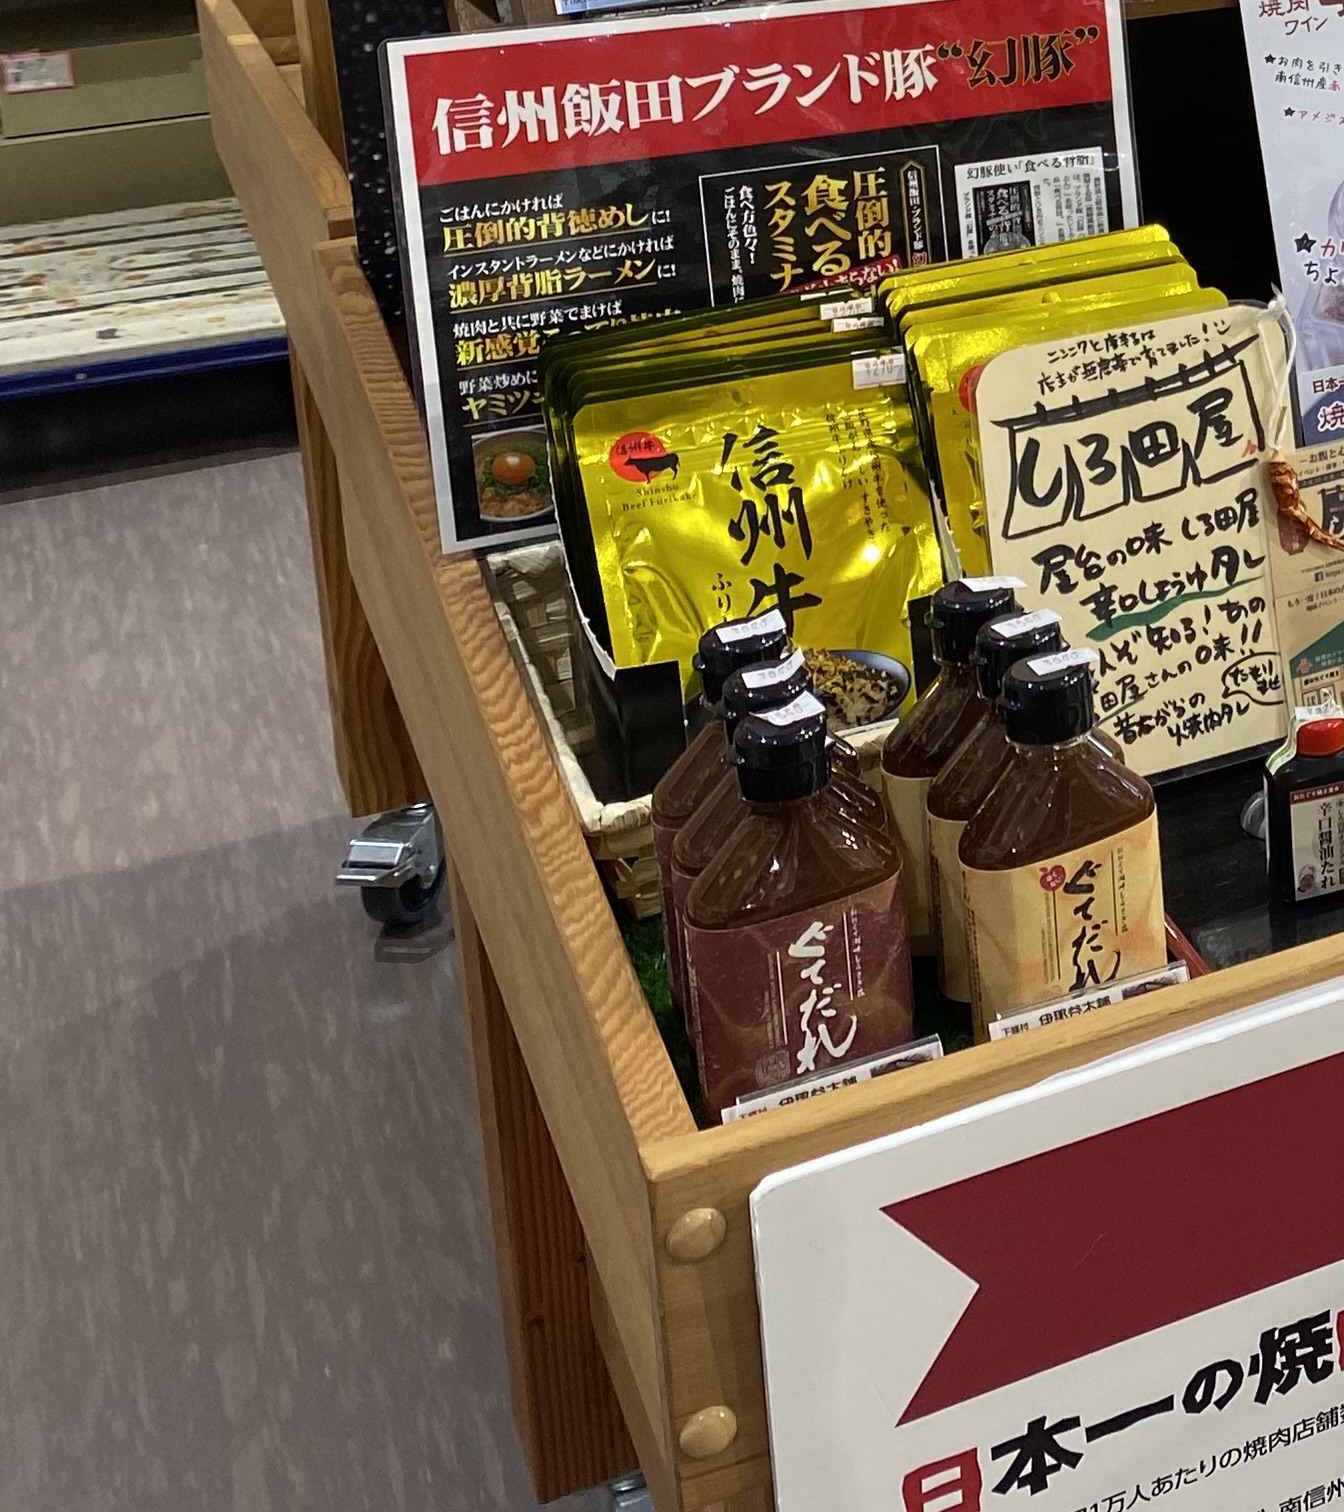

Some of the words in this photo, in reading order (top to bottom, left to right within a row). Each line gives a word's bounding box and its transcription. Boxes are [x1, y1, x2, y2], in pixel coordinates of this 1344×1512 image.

[1283, 16, 1328, 36] ワイン
[431, 25, 1101, 156] 信州飯田ブランド豚“幻豚”
[439, 193, 563, 224] ごはんにかければ
[802, 174, 853, 275] 食べる
[851, 167, 893, 260] 圧倒的
[447, 234, 675, 279] インスタントラーメンなどにかければ
[765, 180, 804, 292] スタミナ
[448, 259, 677, 308] 濃厚背脂ラーメンに!
[453, 299, 623, 339] 焼肉と共に野菜でまけば
